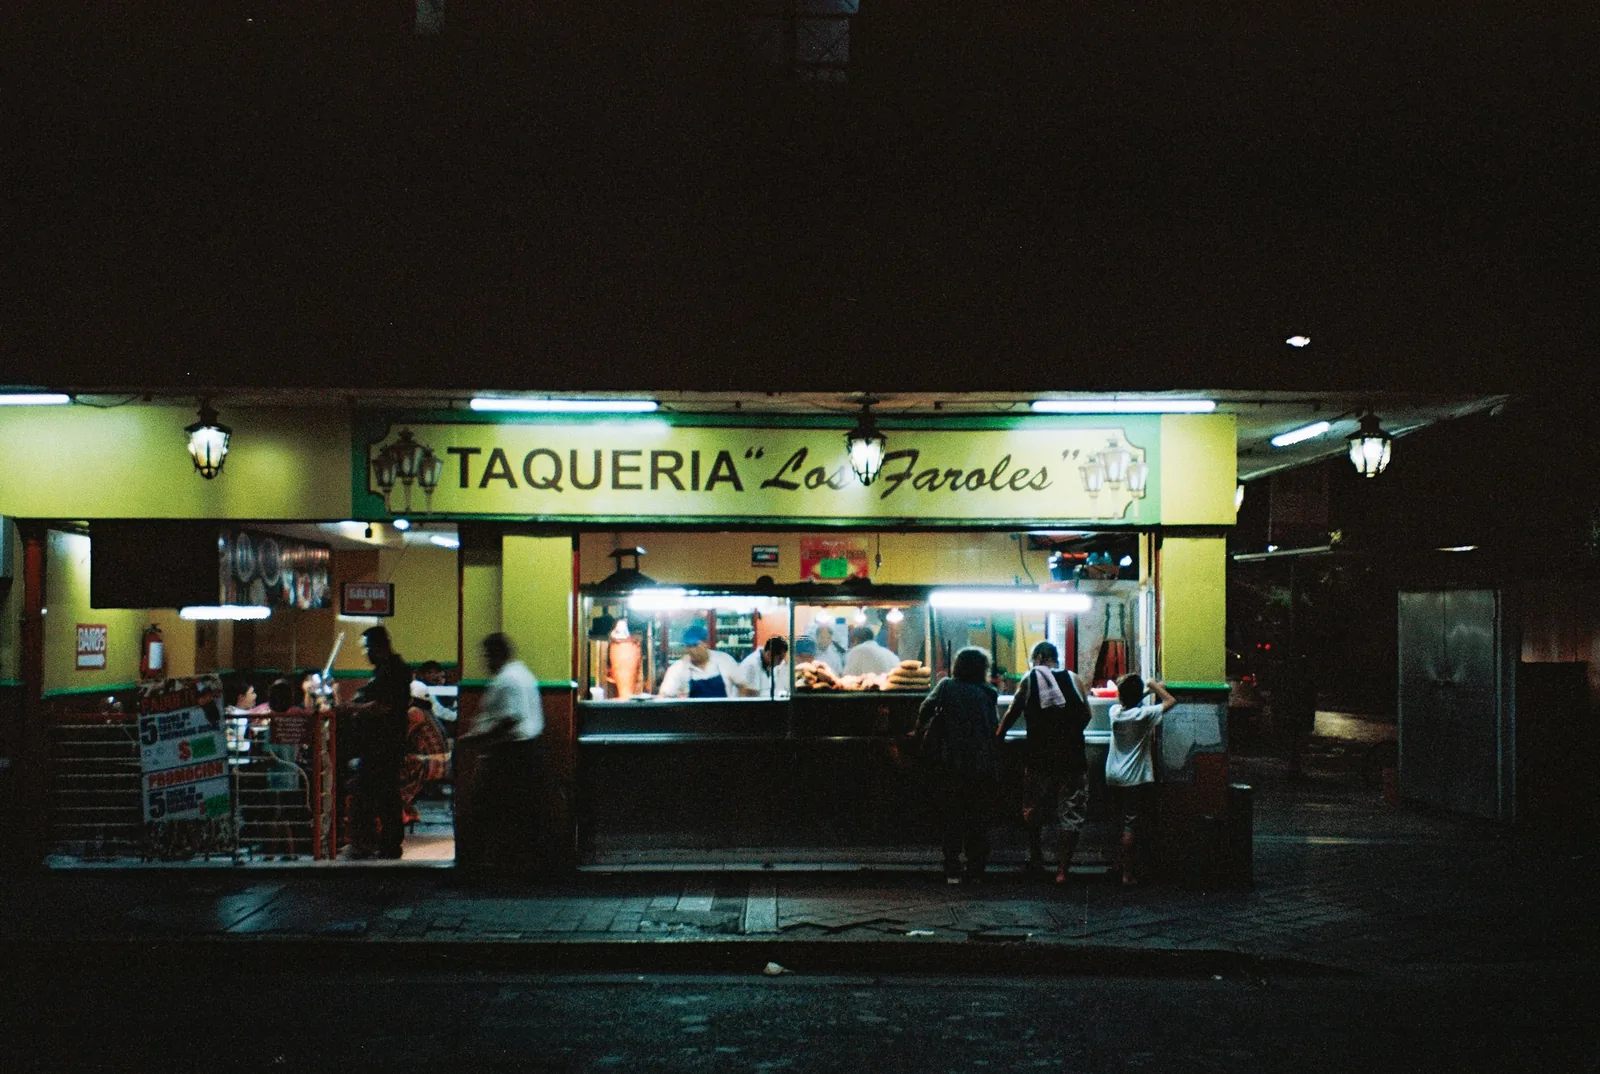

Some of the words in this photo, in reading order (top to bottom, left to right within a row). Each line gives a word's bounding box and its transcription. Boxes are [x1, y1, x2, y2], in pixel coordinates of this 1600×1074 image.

[447, 447, 744, 492] TAQUERIA
[140, 716, 158, 746] 5
[149, 790, 166, 819] 5
